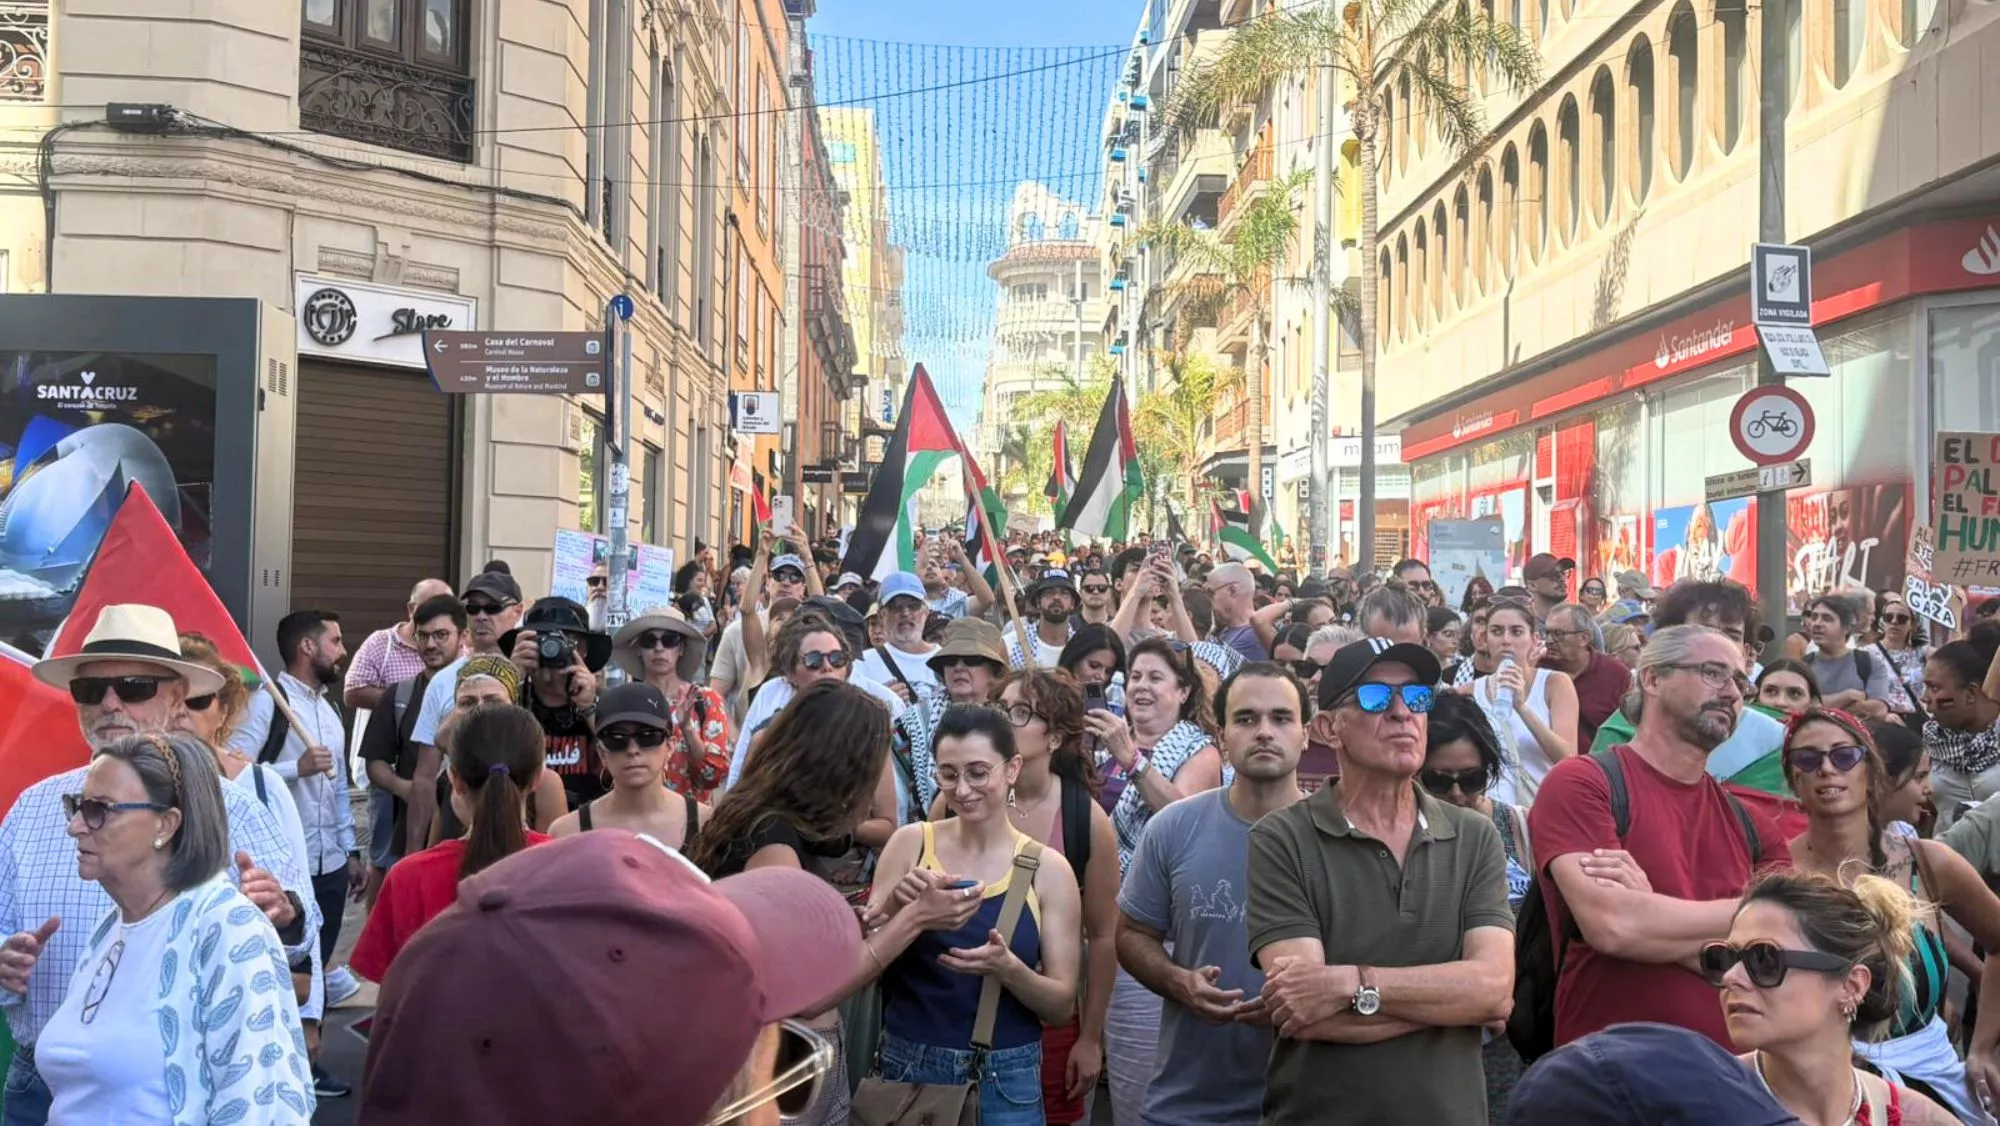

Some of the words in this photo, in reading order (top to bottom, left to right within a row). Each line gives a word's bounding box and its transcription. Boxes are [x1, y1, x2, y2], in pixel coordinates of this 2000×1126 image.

[391, 308, 452, 334] Store
[1760, 307, 1778, 317] ZONA
[1779, 308, 1809, 319] VIGILADA
[484, 337, 504, 347] Casa
[505, 337, 519, 347] del
[520, 337, 555, 347] Carnaval
[1671, 319, 1735, 363] Santander
[485, 366, 509, 374] Museo
[510, 366, 519, 374] de
[520, 366, 529, 374] la
[529, 366, 569, 374] Naturaleza
[1944, 438, 1980, 464] EL
[1943, 493, 1968, 514] EL
[1794, 536, 1880, 597] START
[1909, 591, 1953, 625] GAZA
